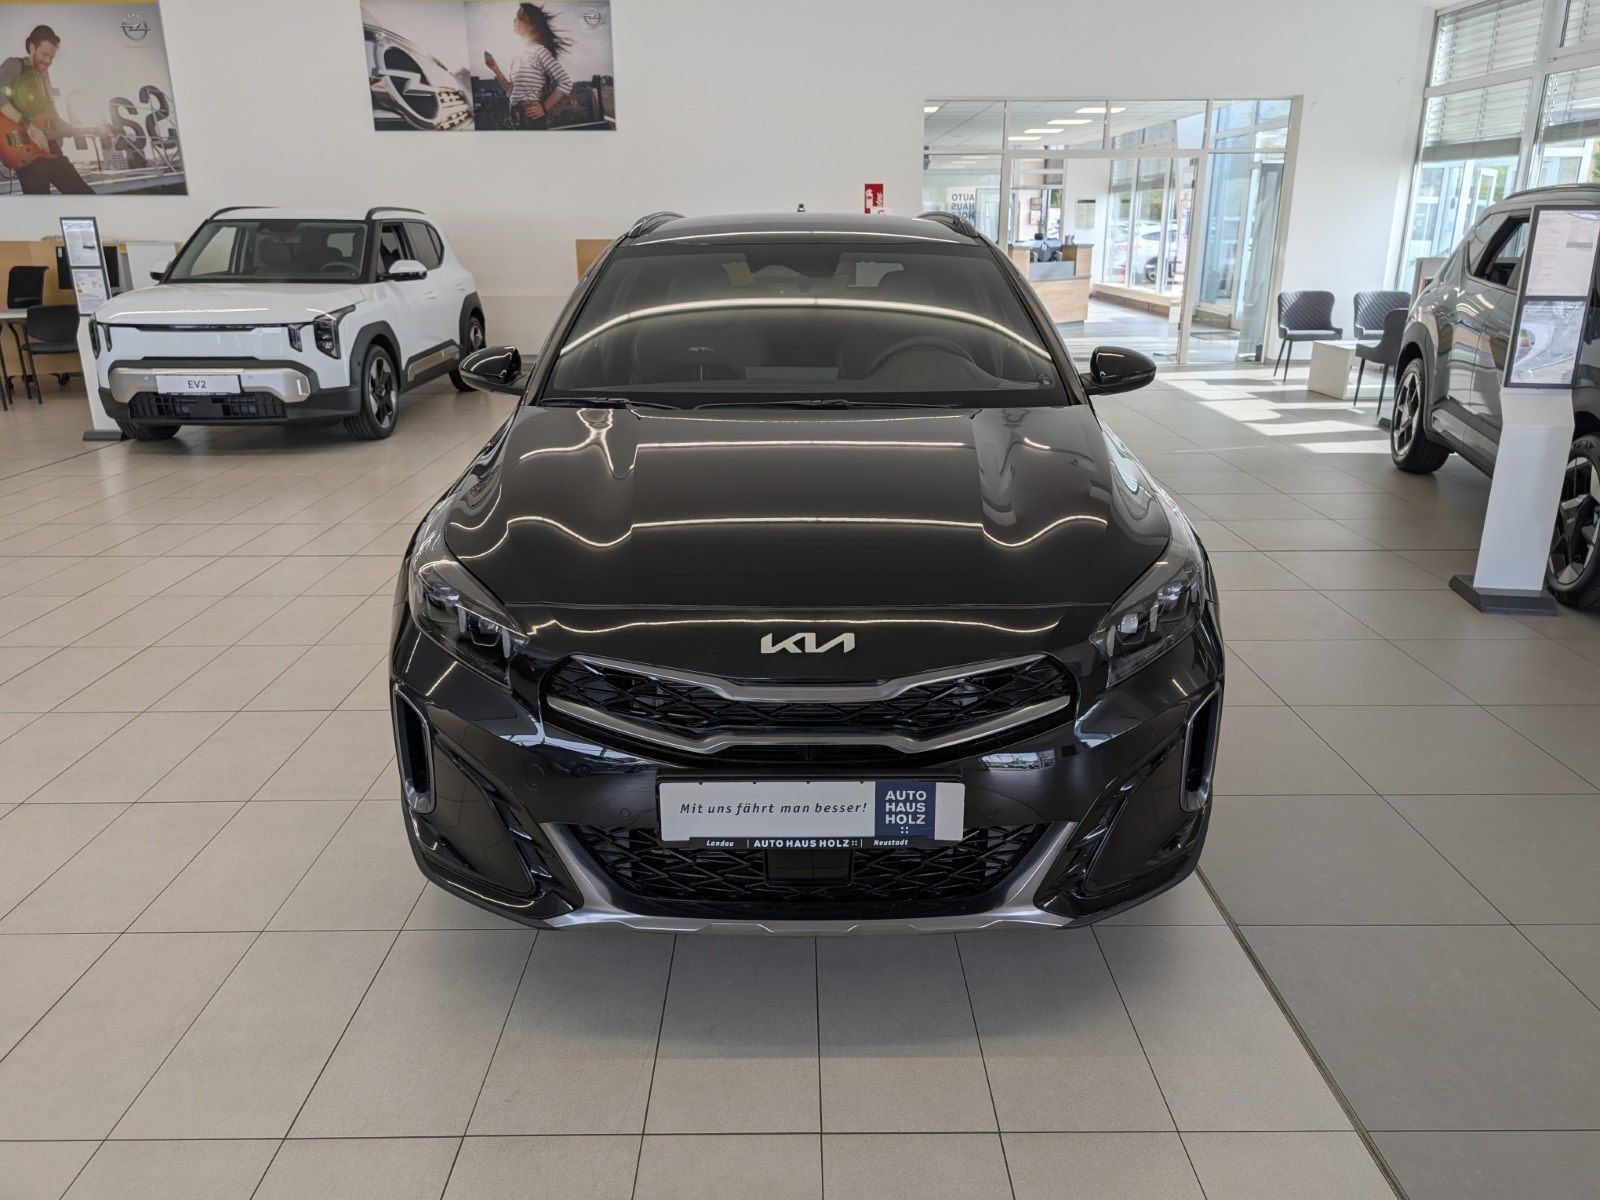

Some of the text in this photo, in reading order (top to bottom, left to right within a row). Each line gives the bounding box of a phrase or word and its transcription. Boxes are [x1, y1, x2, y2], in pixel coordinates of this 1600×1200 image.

[187, 380, 207, 389] EV2
[885, 790, 927, 801] AUTO
[680, 803, 867, 816] Mit uns fährt man besser!
[885, 802, 926, 813] HAUS
[885, 814, 926, 825] HOLZ
[753, 839, 784, 848] AUTO
[786, 839, 817, 848] HAUS
[819, 839, 850, 848] HOLZ
